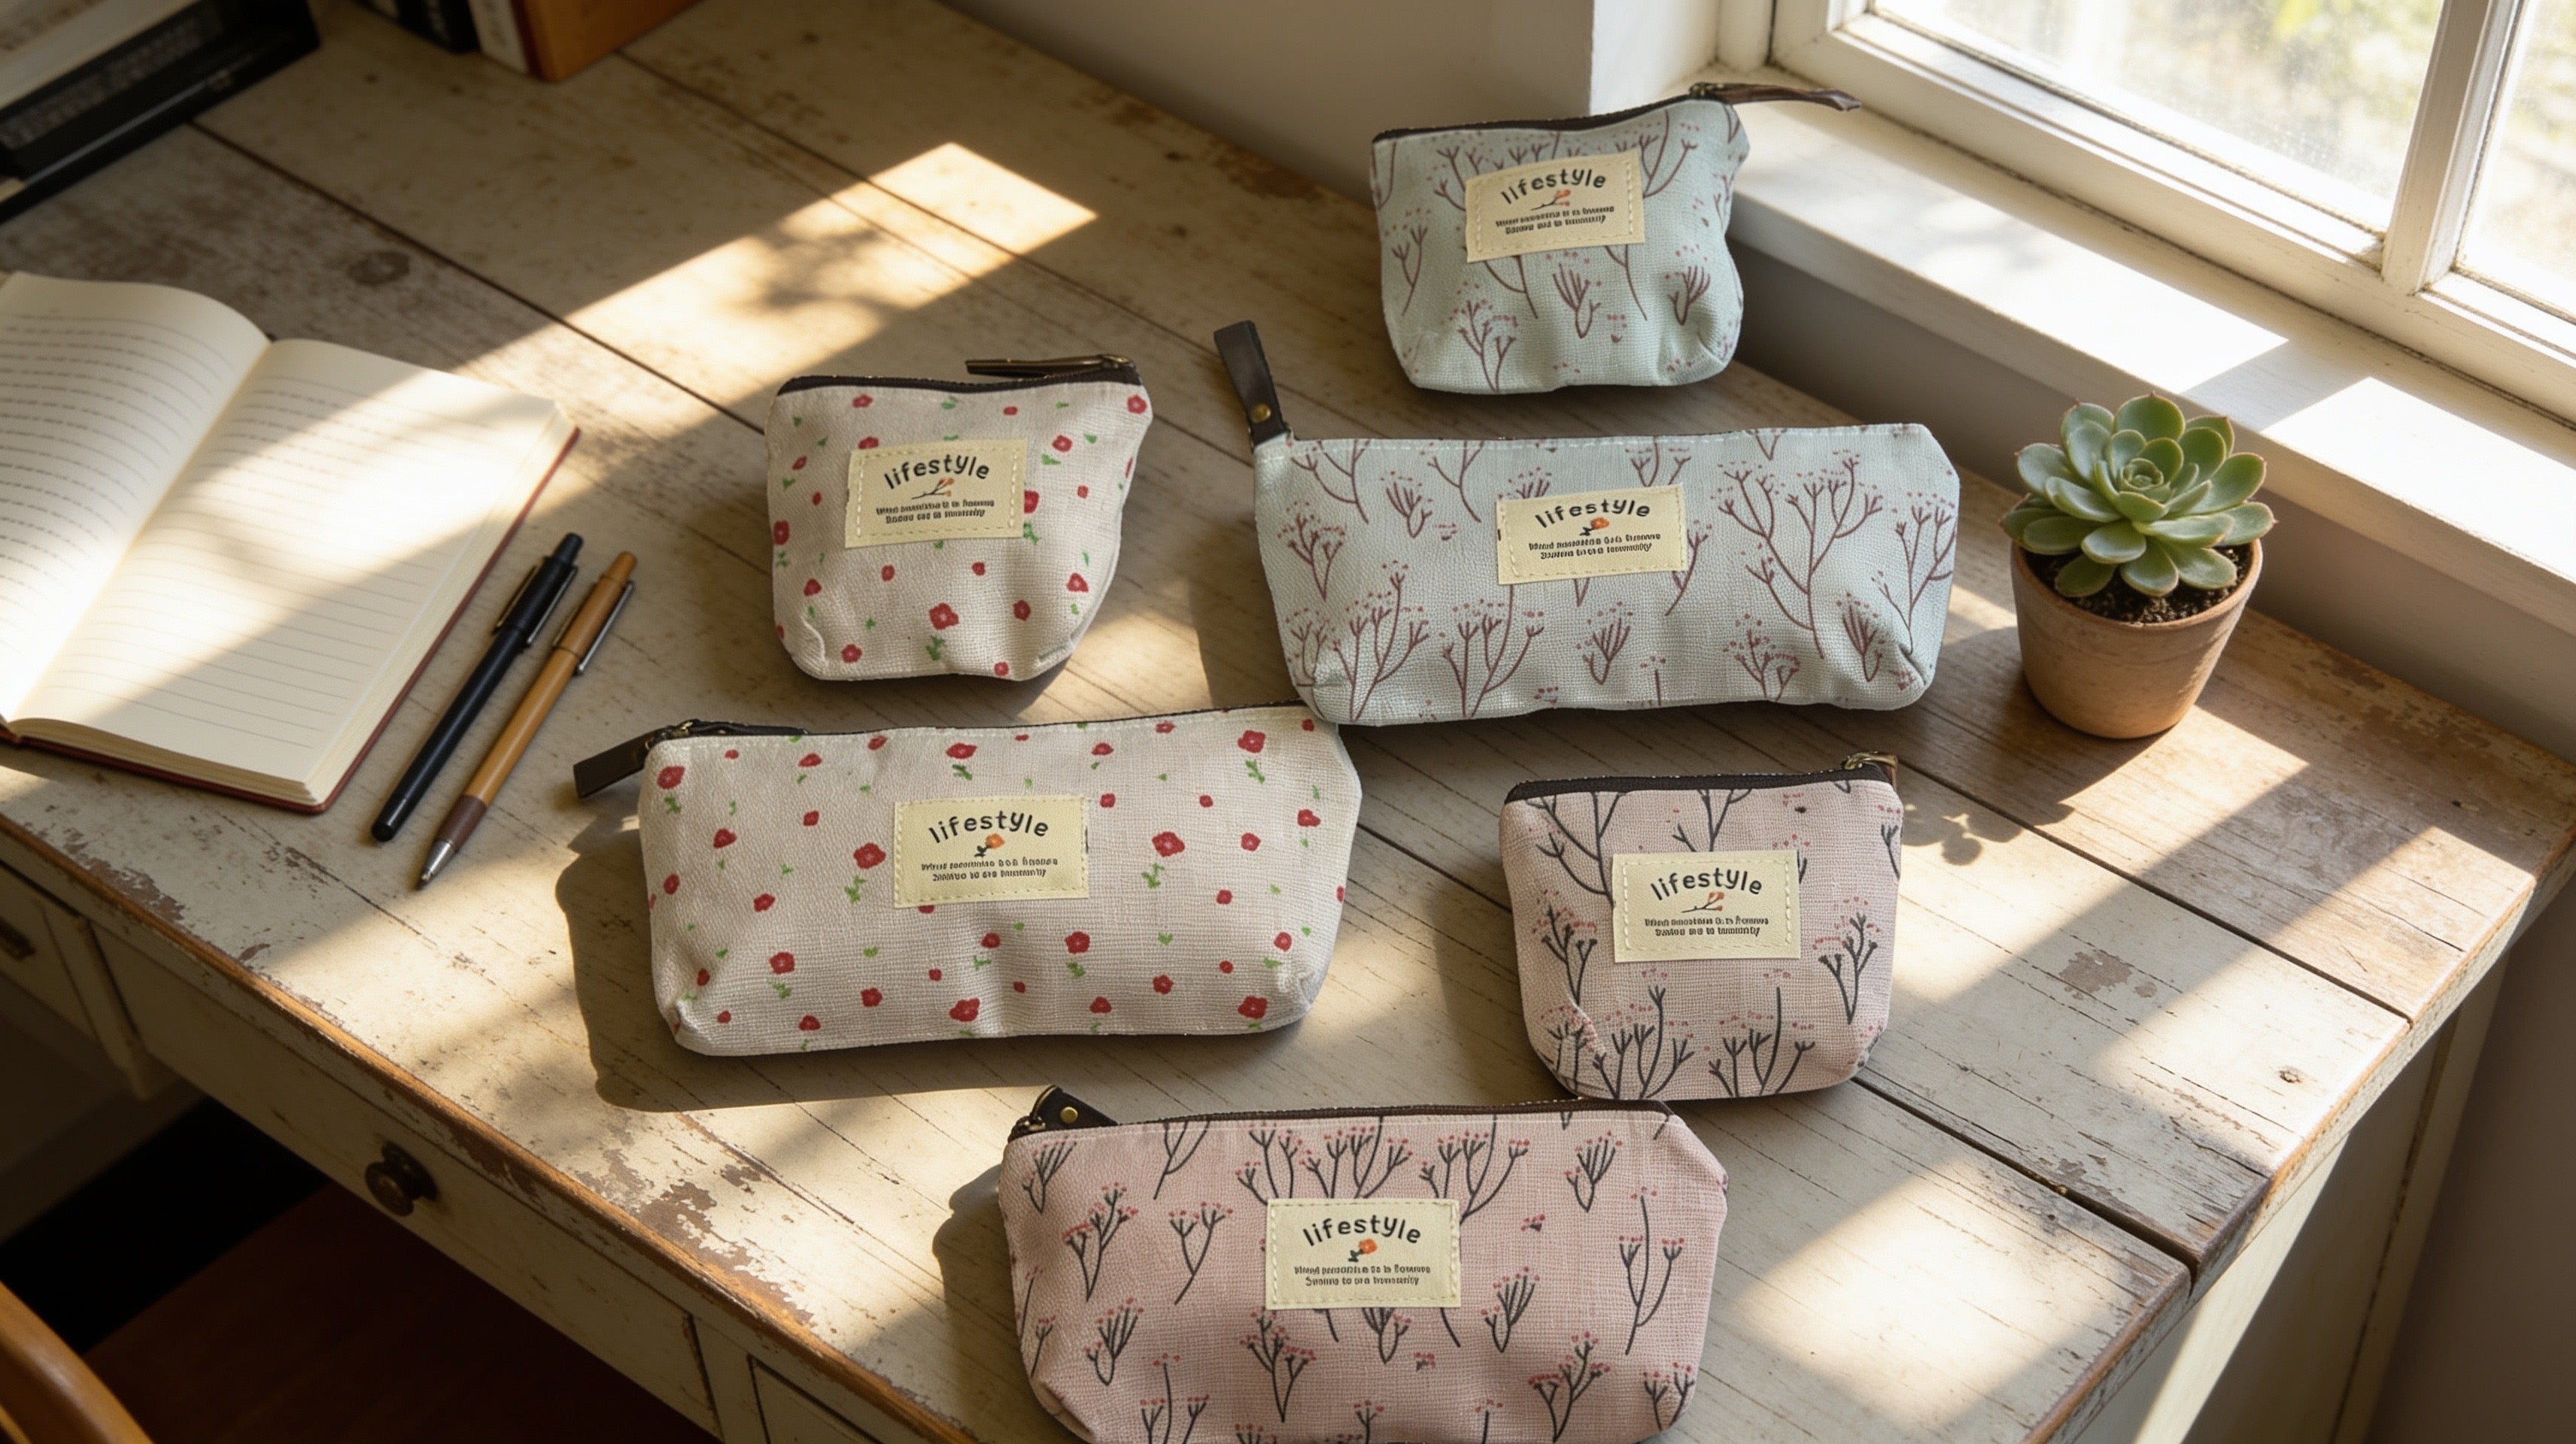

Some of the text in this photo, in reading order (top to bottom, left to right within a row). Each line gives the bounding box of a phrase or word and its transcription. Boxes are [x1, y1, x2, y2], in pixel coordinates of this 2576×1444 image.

[884, 454, 989, 490] lifestyle
[1535, 499, 1651, 528] lifestyle
[928, 810, 1049, 843] lifestyle
[1651, 867, 1762, 901] lifestyle
[1303, 1215, 1421, 1247] lifestyle
